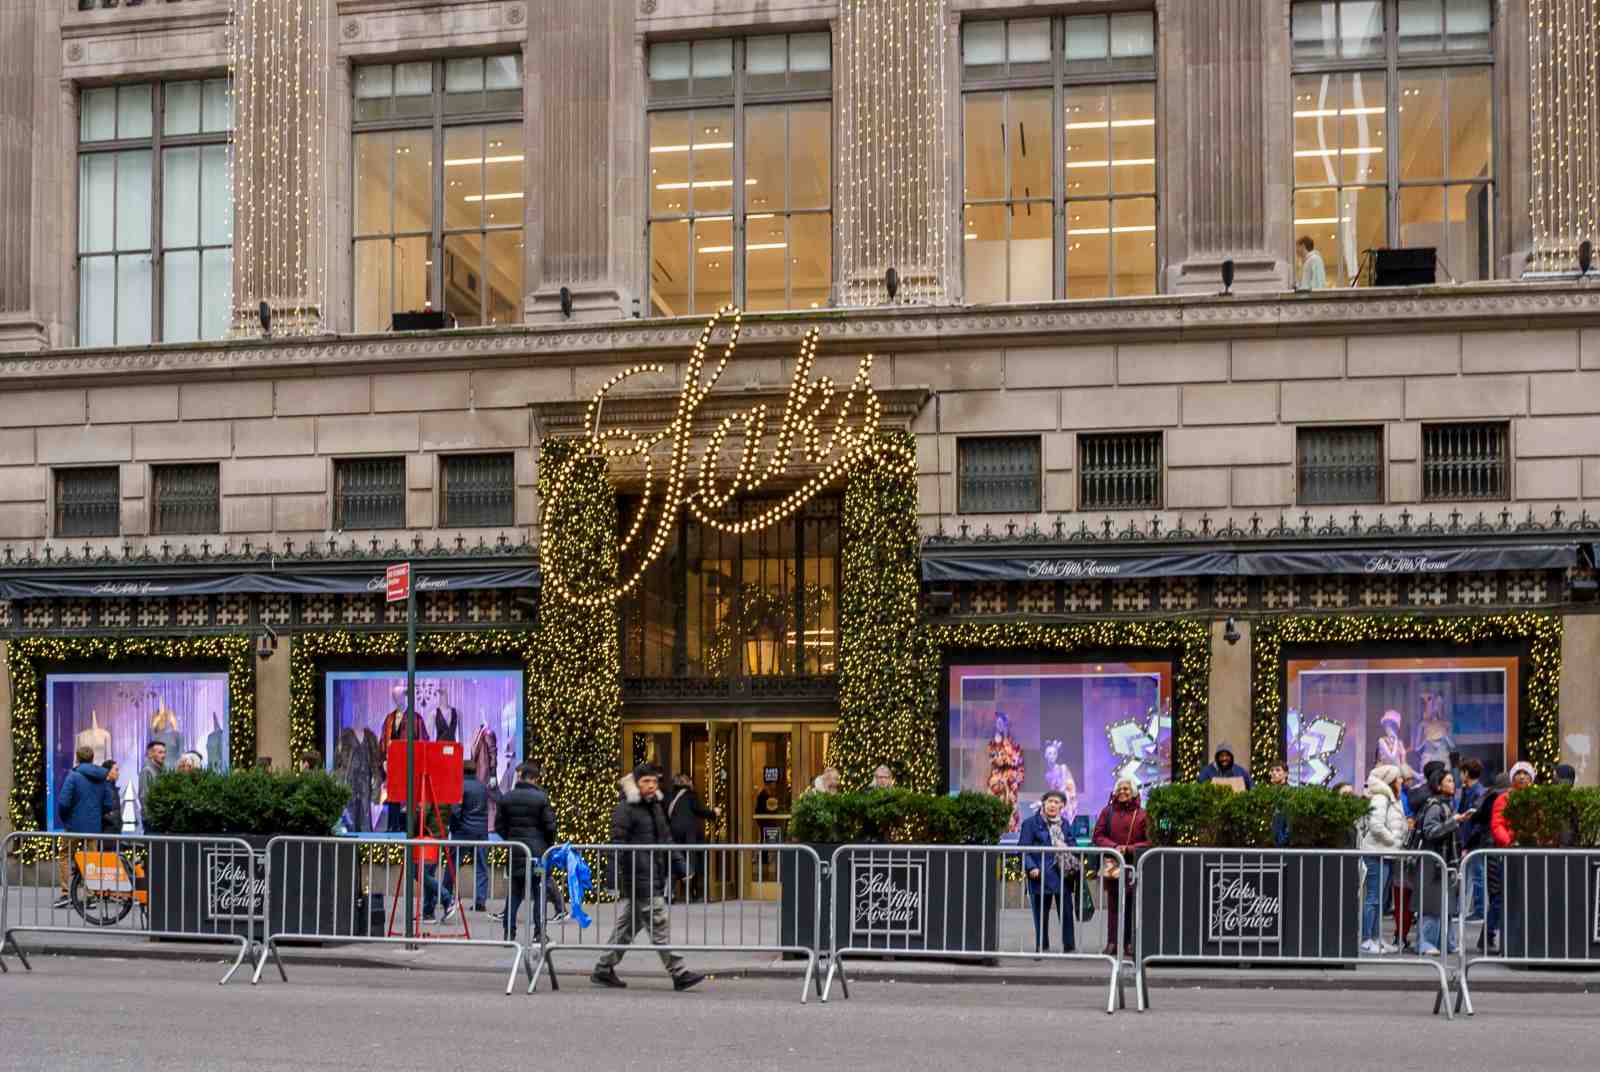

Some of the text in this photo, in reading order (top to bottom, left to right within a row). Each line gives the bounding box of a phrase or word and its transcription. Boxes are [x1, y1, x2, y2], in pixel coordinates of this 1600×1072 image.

[543, 304, 914, 606] Saks
[1026, 560, 1120, 577] Saks Fifth Avenue
[211, 862, 246, 884] Saks
[855, 872, 896, 898] Saks
[1208, 878, 1256, 904] Saks
[855, 900, 914, 924] Avenue
[1235, 894, 1280, 917] Fifth
[1208, 906, 1274, 932] Avenue
